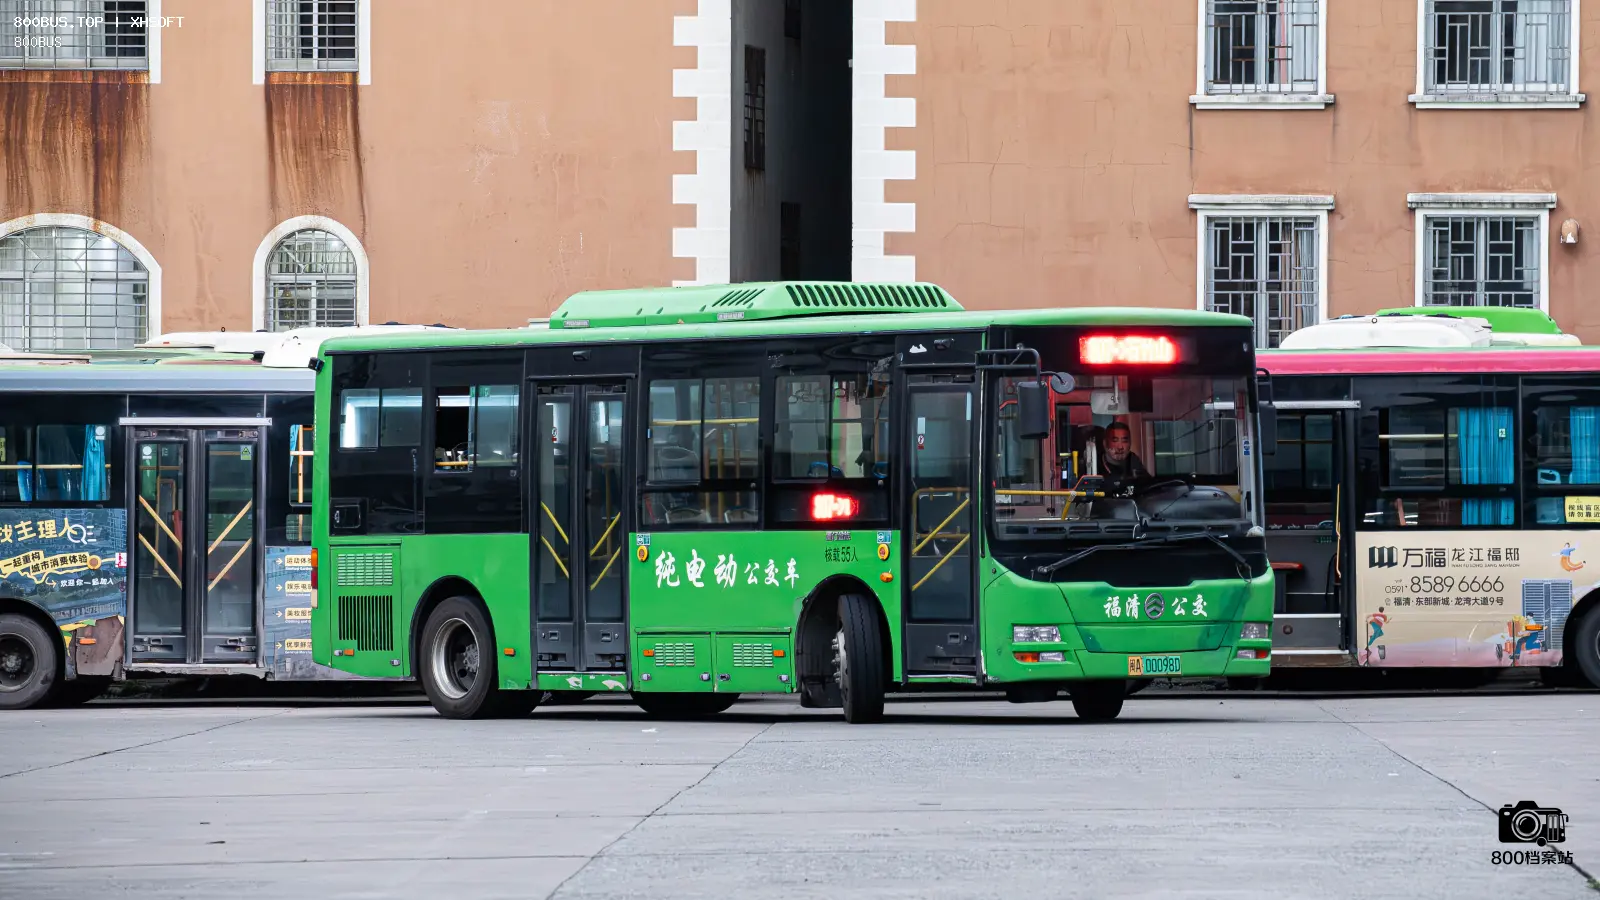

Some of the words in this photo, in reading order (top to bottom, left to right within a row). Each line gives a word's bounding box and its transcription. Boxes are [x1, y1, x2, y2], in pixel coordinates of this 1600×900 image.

[3, 551, 41, 568] 一起重构
[31, 554, 88, 573] 城市消费体验
[824, 546, 859, 563] 核载55人
[1402, 548, 1446, 568] 万福
[1451, 548, 1520, 562] 龙江福邸
[60, 577, 114, 588] 欢迎你一起加入
[1384, 585, 1404, 594] 0591
[1410, 575, 1455, 593] 8589
[1458, 575, 1504, 593] 6666
[1103, 594, 1141, 619] 福清
[1171, 594, 1208, 617] 公交
